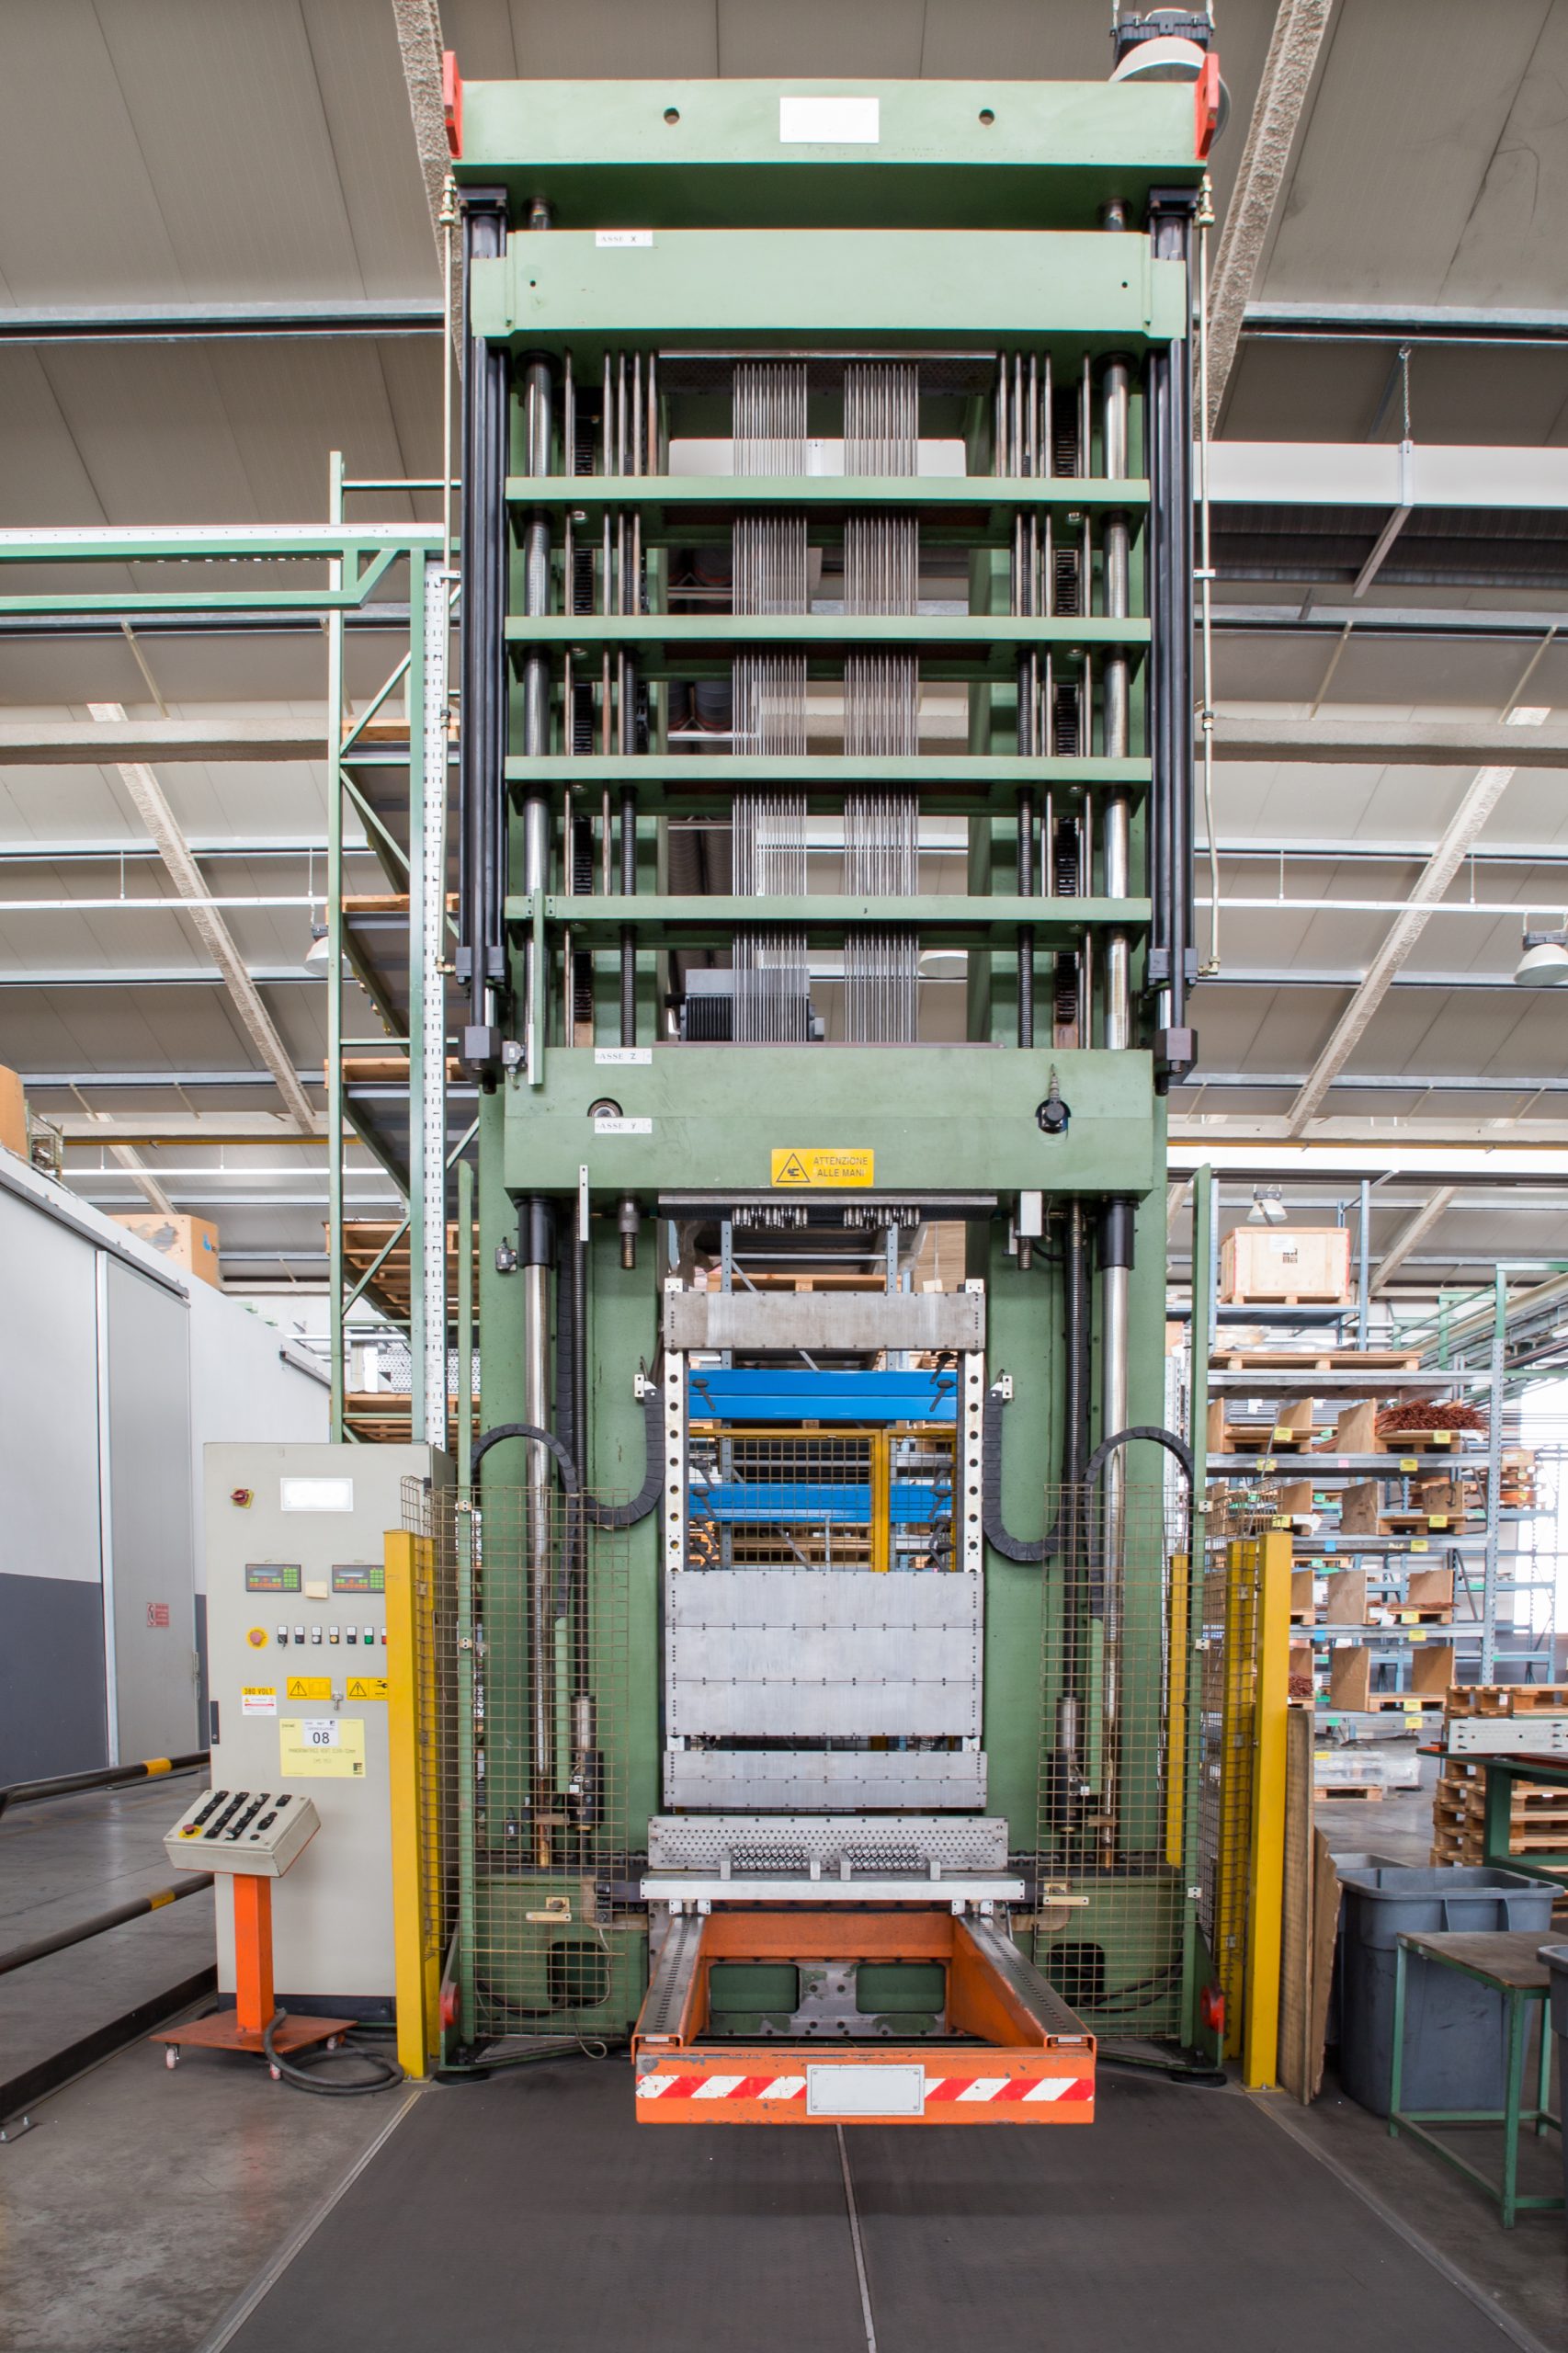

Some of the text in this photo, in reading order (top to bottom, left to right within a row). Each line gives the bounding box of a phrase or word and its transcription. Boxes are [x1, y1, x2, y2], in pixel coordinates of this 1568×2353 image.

[813, 1156, 869, 1165] ATTENZIONE
[817, 1168, 865, 1177] ALLE MANI
[312, 1732, 330, 1745] 08
